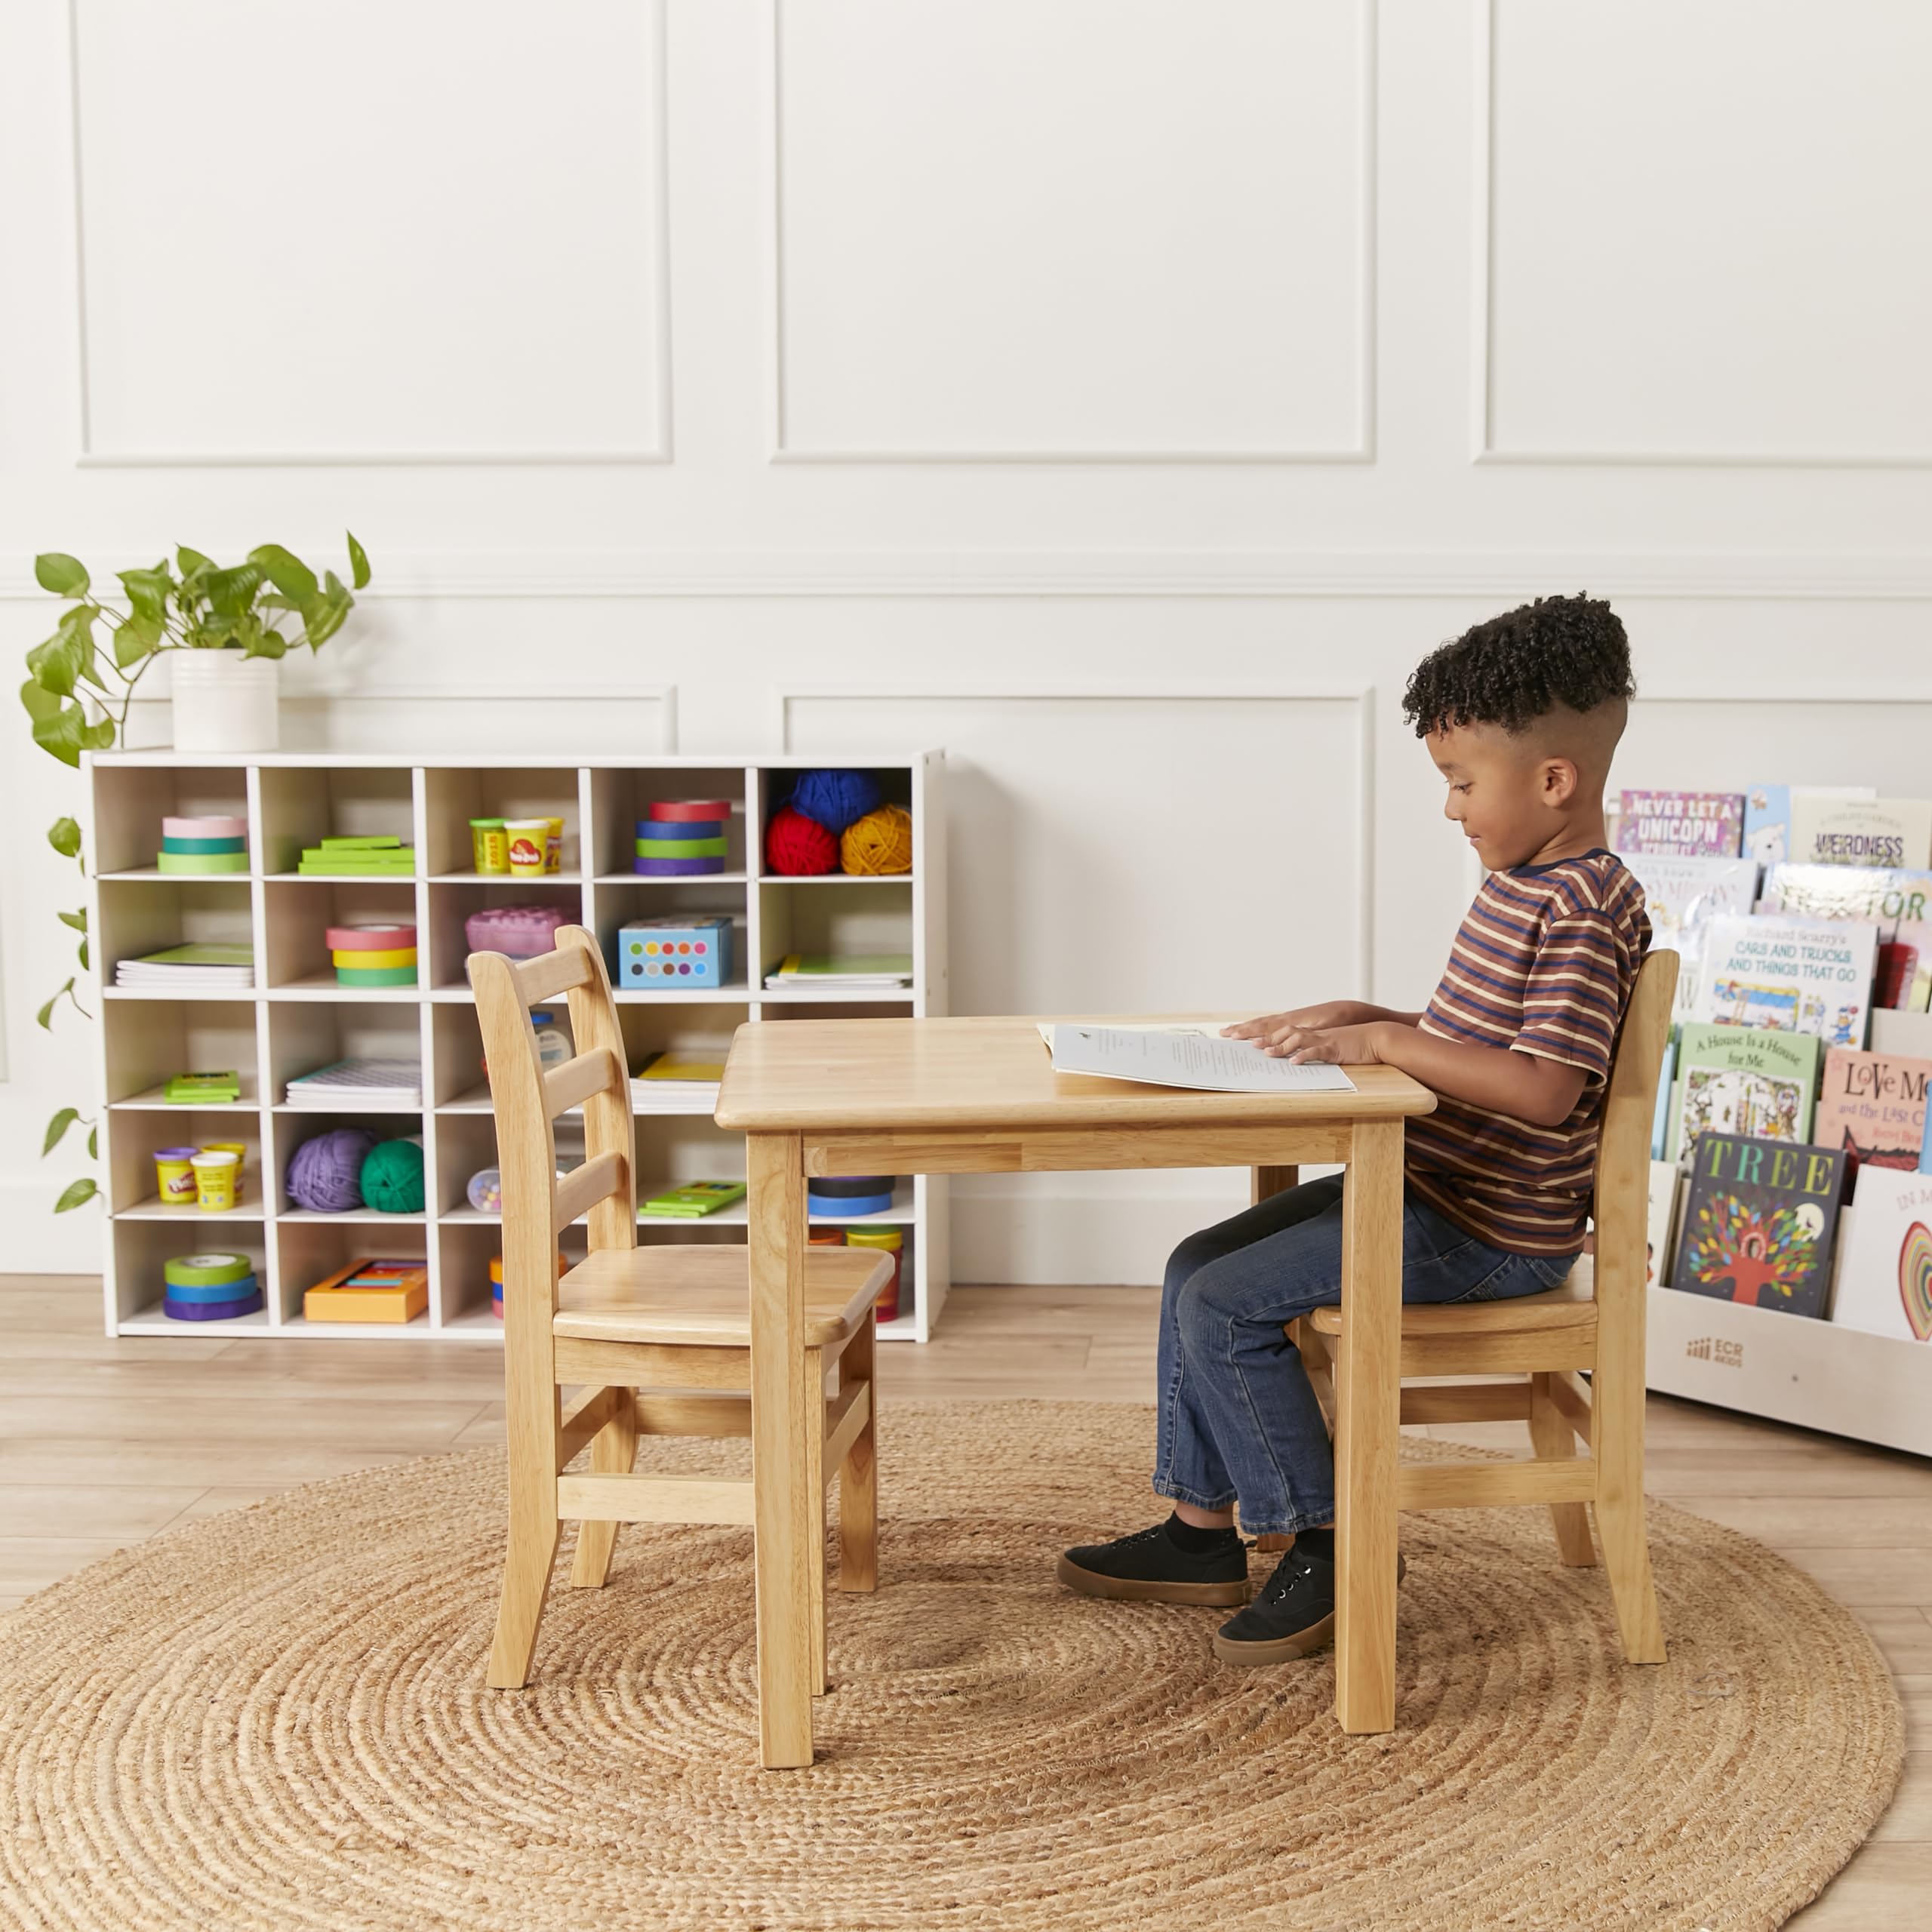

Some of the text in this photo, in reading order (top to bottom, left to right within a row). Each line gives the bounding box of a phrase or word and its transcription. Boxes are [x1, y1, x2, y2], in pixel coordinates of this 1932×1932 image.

[1633, 796, 1733, 820] NEVER LET A
[1638, 817, 1719, 843] UNICORN
[1735, 941, 1852, 964] CARS AND TRUCKS
[1726, 958, 1857, 983] AND THINGS THAT GO
[1697, 1033, 1802, 1067] A House Is a House
[1727, 1051, 1764, 1069] for Me
[1703, 1138, 1835, 1197] TREE
[1714, 1338, 1744, 1356] ECR
